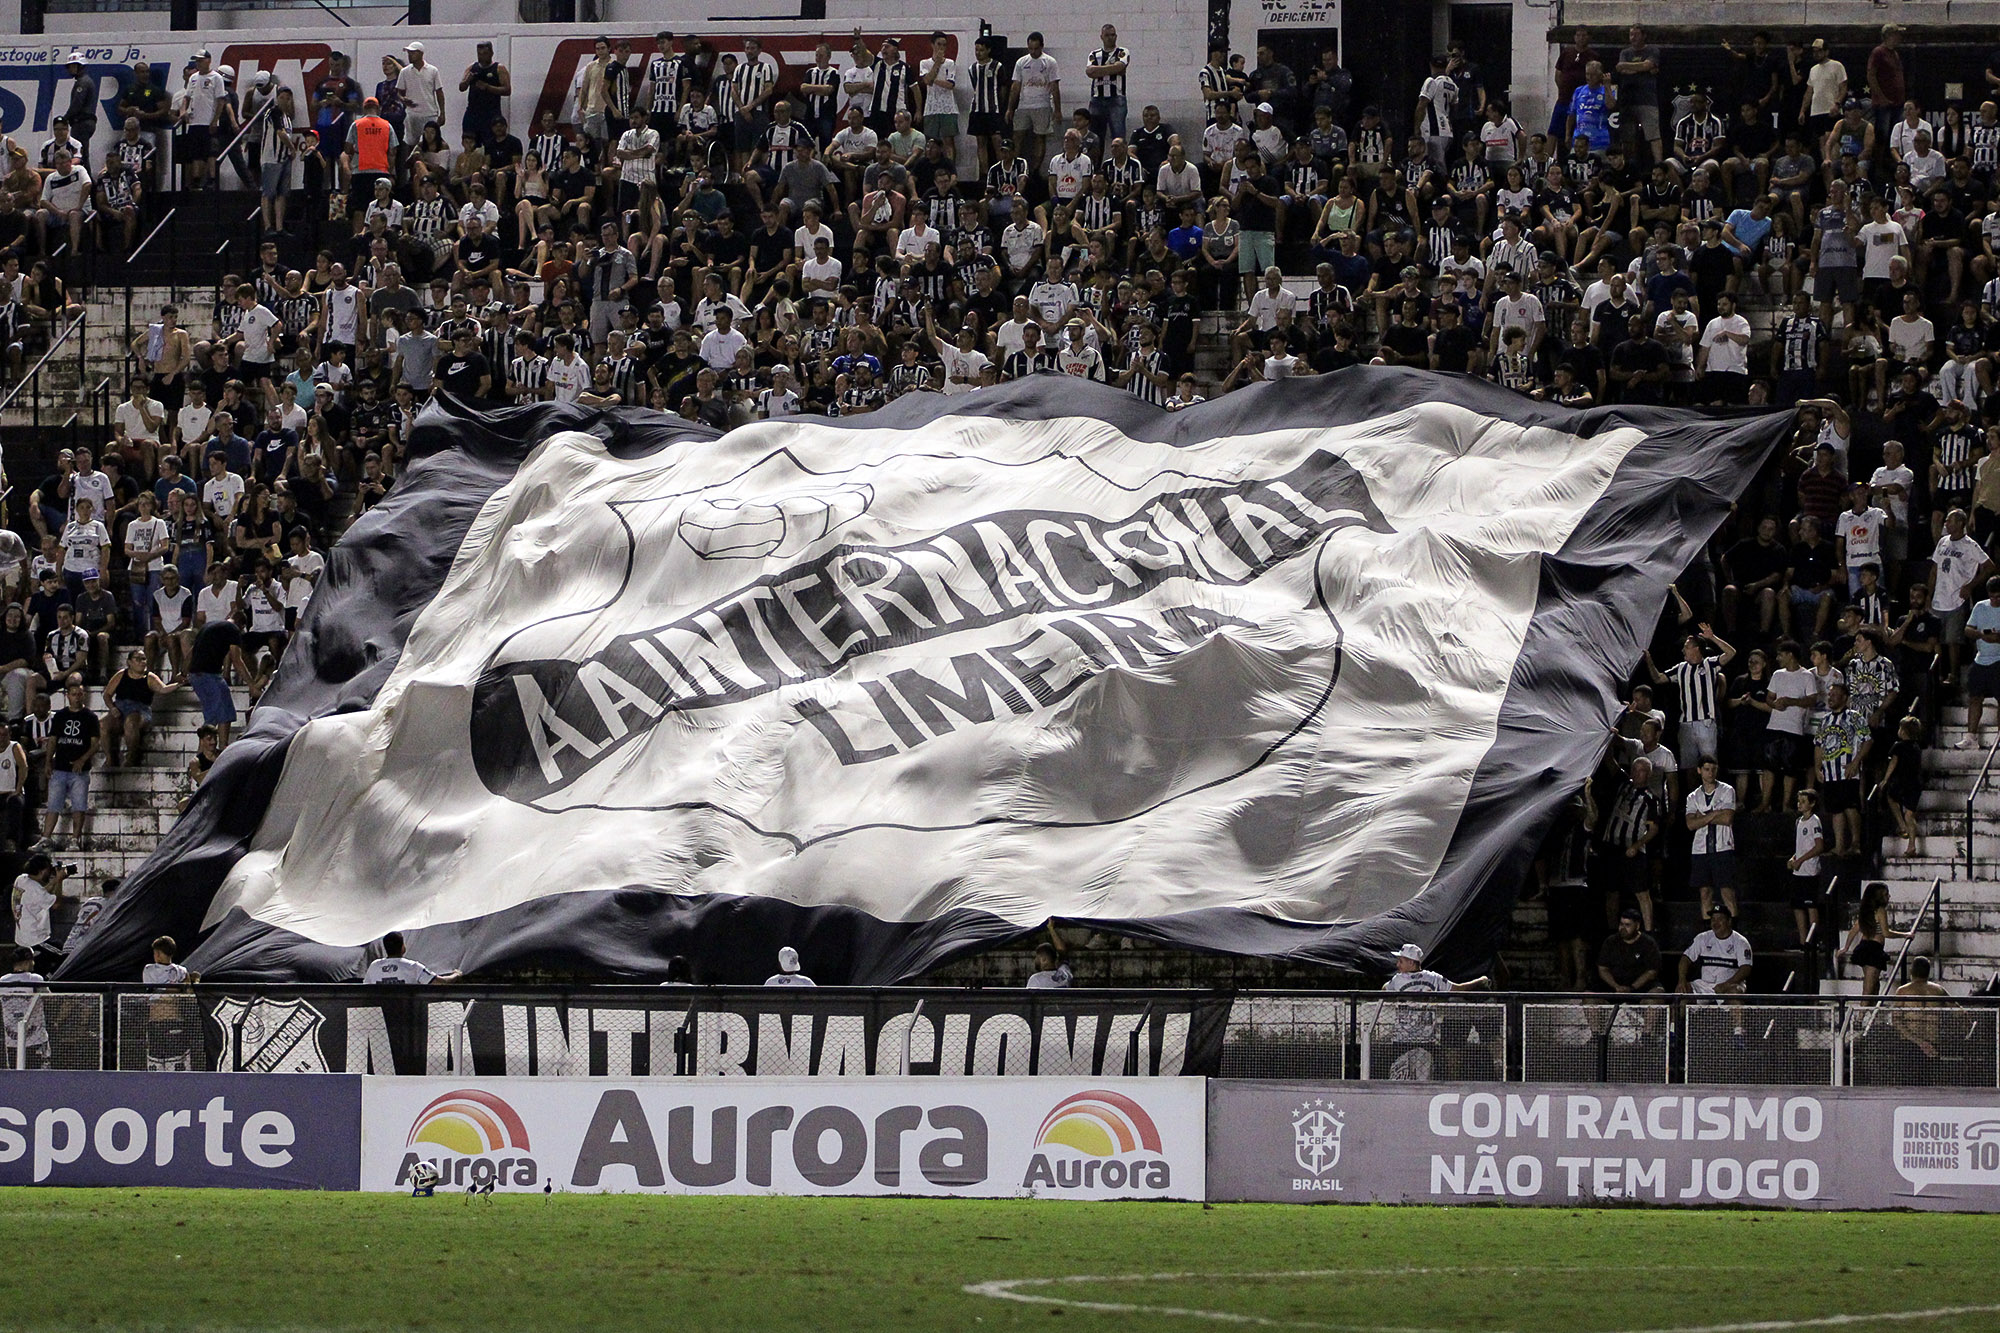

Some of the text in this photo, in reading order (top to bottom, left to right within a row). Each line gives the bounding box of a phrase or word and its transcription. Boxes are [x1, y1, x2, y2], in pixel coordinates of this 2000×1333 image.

[629, 481, 1368, 699] INTERNACIONAL
[1428, 1093, 1823, 1142] COM RACISMO
[1903, 1122, 1959, 1140] DISQUE
[0, 1096, 296, 1183] sporte
[571, 1089, 989, 1187] Aurora
[1308, 1137, 1328, 1145] CBF
[1902, 1141, 1959, 1155] DIREITOS
[395, 1152, 538, 1187] Aurora
[1022, 1153, 1171, 1189] Aurora
[1430, 1144, 1821, 1200] NÃO TEM JOGO
[1902, 1156, 1959, 1169] HUMANOS
[1966, 1142, 2000, 1170] 10
[1292, 1179, 1344, 1191] BRASIL
